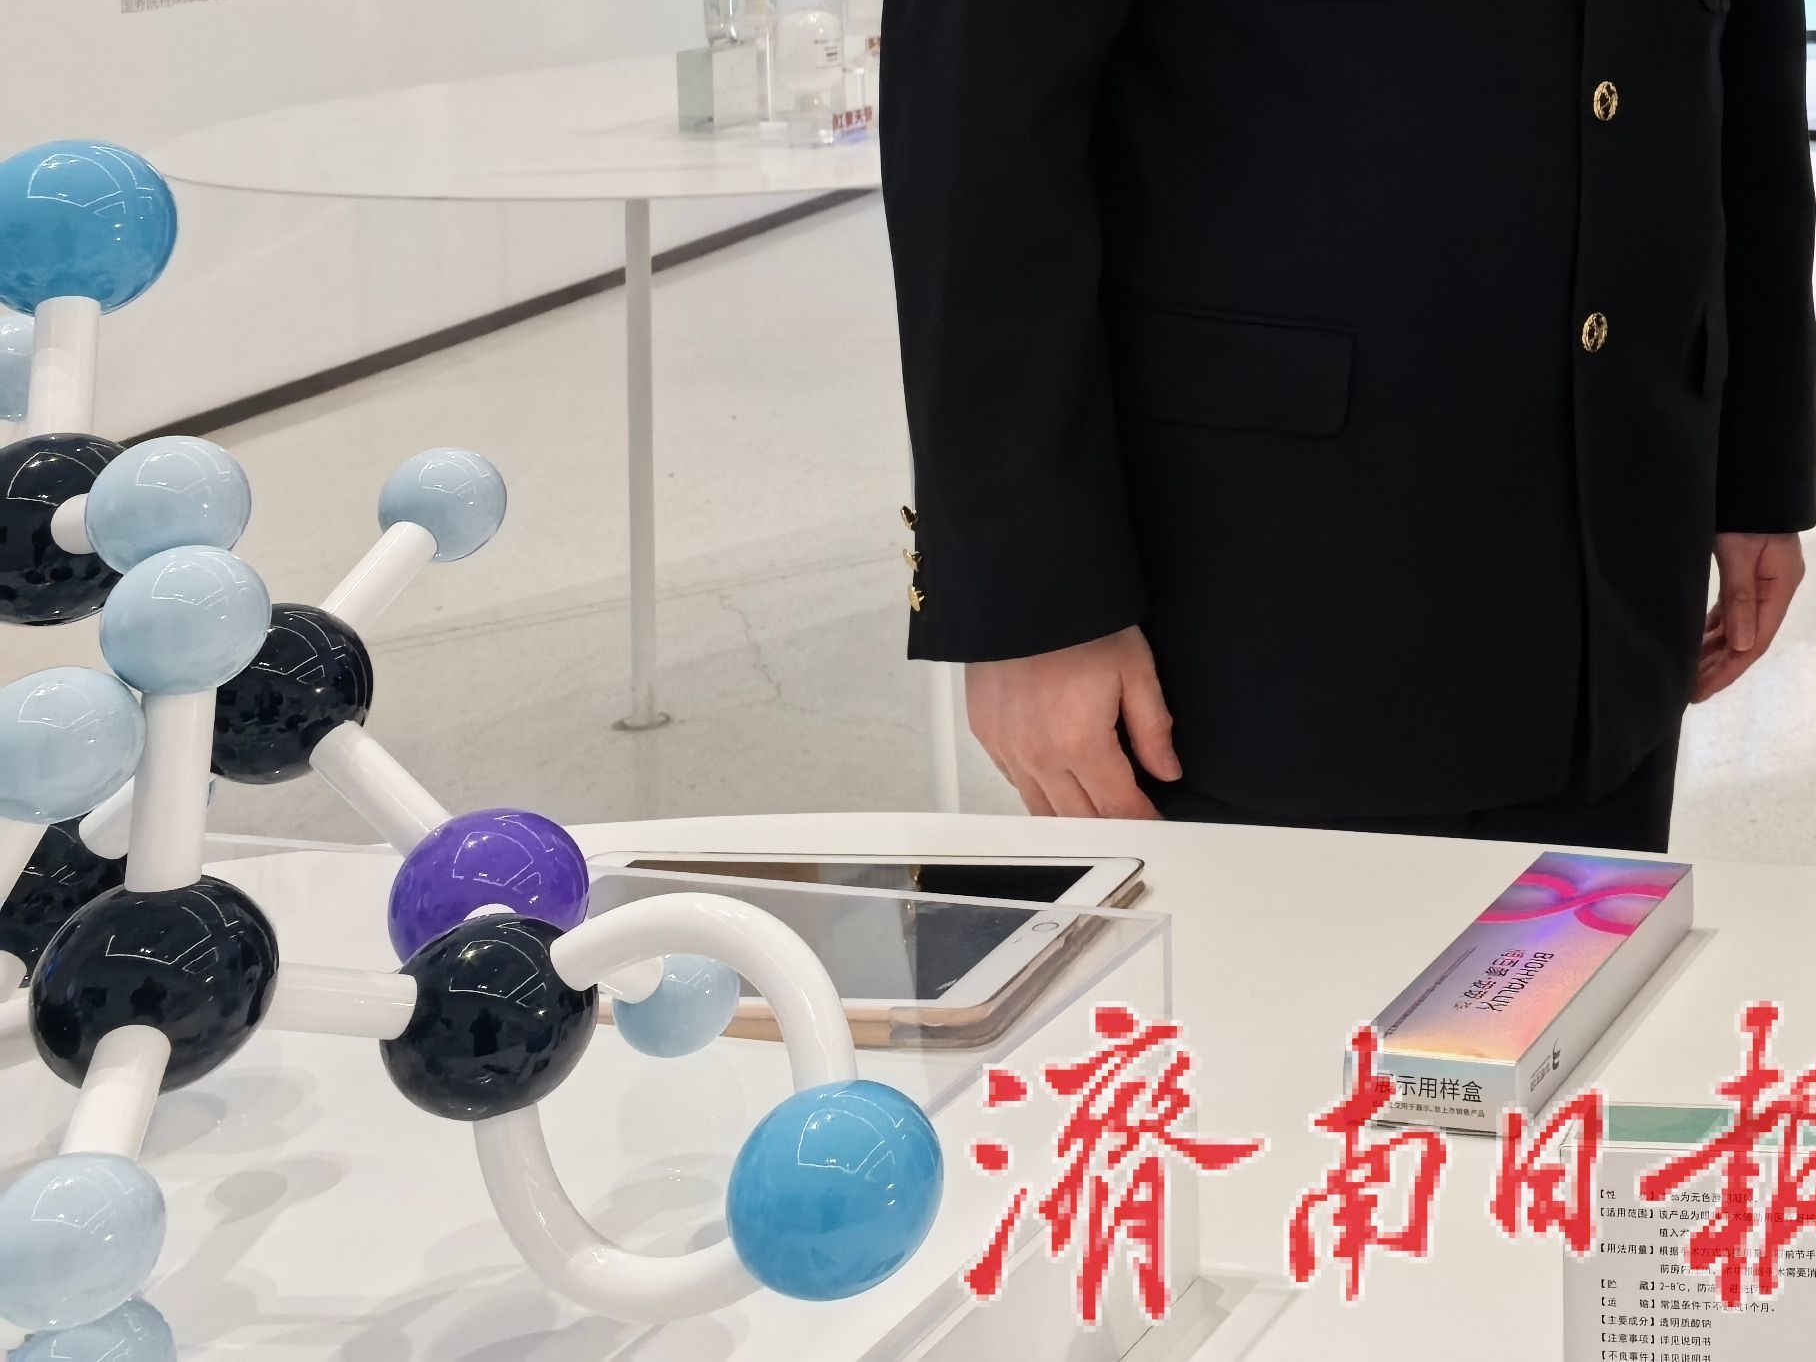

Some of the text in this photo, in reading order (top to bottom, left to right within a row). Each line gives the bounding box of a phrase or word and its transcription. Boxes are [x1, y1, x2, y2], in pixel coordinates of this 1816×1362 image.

[1374, 1072, 1483, 1103] 展示用样盒
